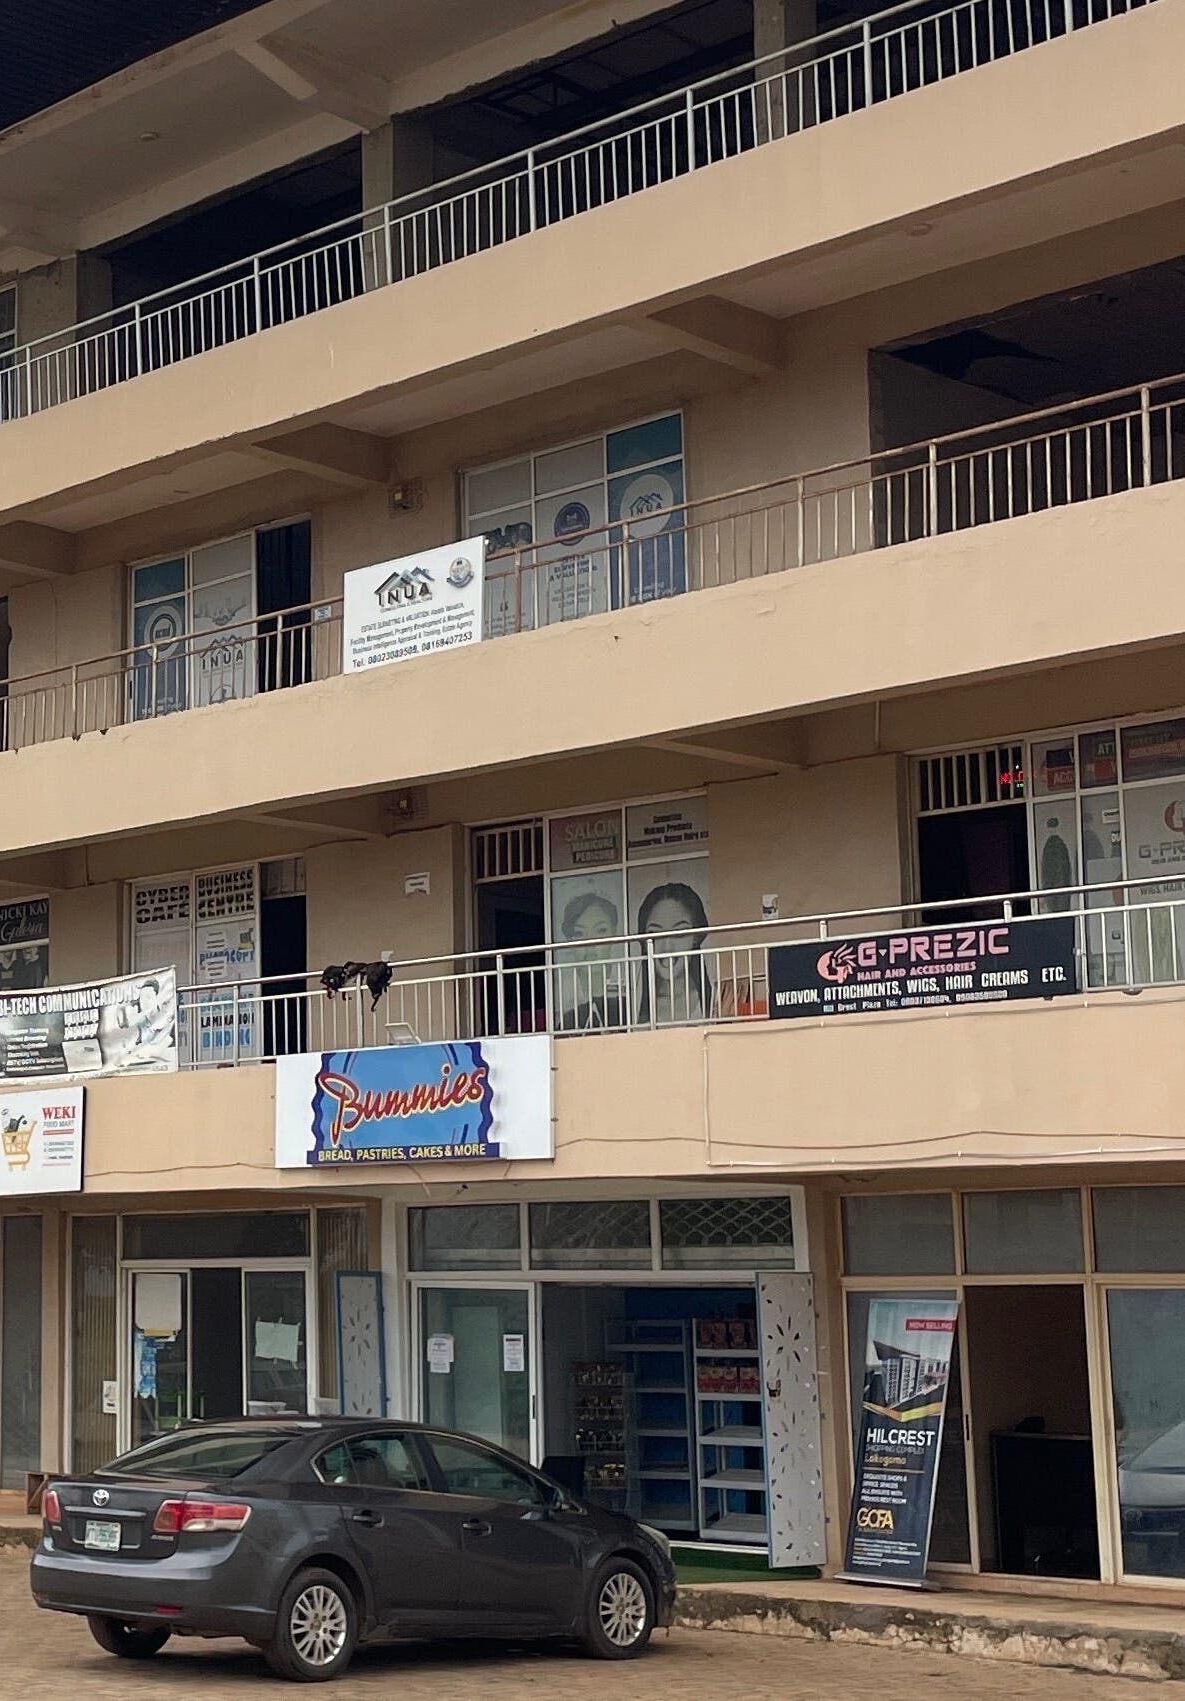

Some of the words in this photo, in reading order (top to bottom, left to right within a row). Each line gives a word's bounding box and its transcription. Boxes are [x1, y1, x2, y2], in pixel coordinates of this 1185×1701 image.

[377, 582, 430, 606] INUA
[202, 649, 244, 671] INUA
[857, 969, 883, 981] HAIR
[884, 967, 906, 979] AND
[909, 961, 977, 977] ACCESSORIES
[776, 989, 821, 1006] WEAVON,
[824, 980, 902, 1001] ATTACHMENTS,
[907, 978, 940, 994] WIGS,
[945, 975, 973, 990] HAIR
[981, 970, 1029, 987] CREAMS
[1042, 966, 1067, 983] ETC.
[42, 1105, 77, 1120] WEKI
[318, 1063, 487, 1149] Bummies
[318, 1148, 354, 1162] BREAD,
[356, 1147, 407, 1161] PASTRIES,
[409, 1146, 444, 1158] CAKES
[444, 1145, 453, 1157] &
[454, 1143, 486, 1156] MORE
[866, 1427, 935, 1446] HILCREST
